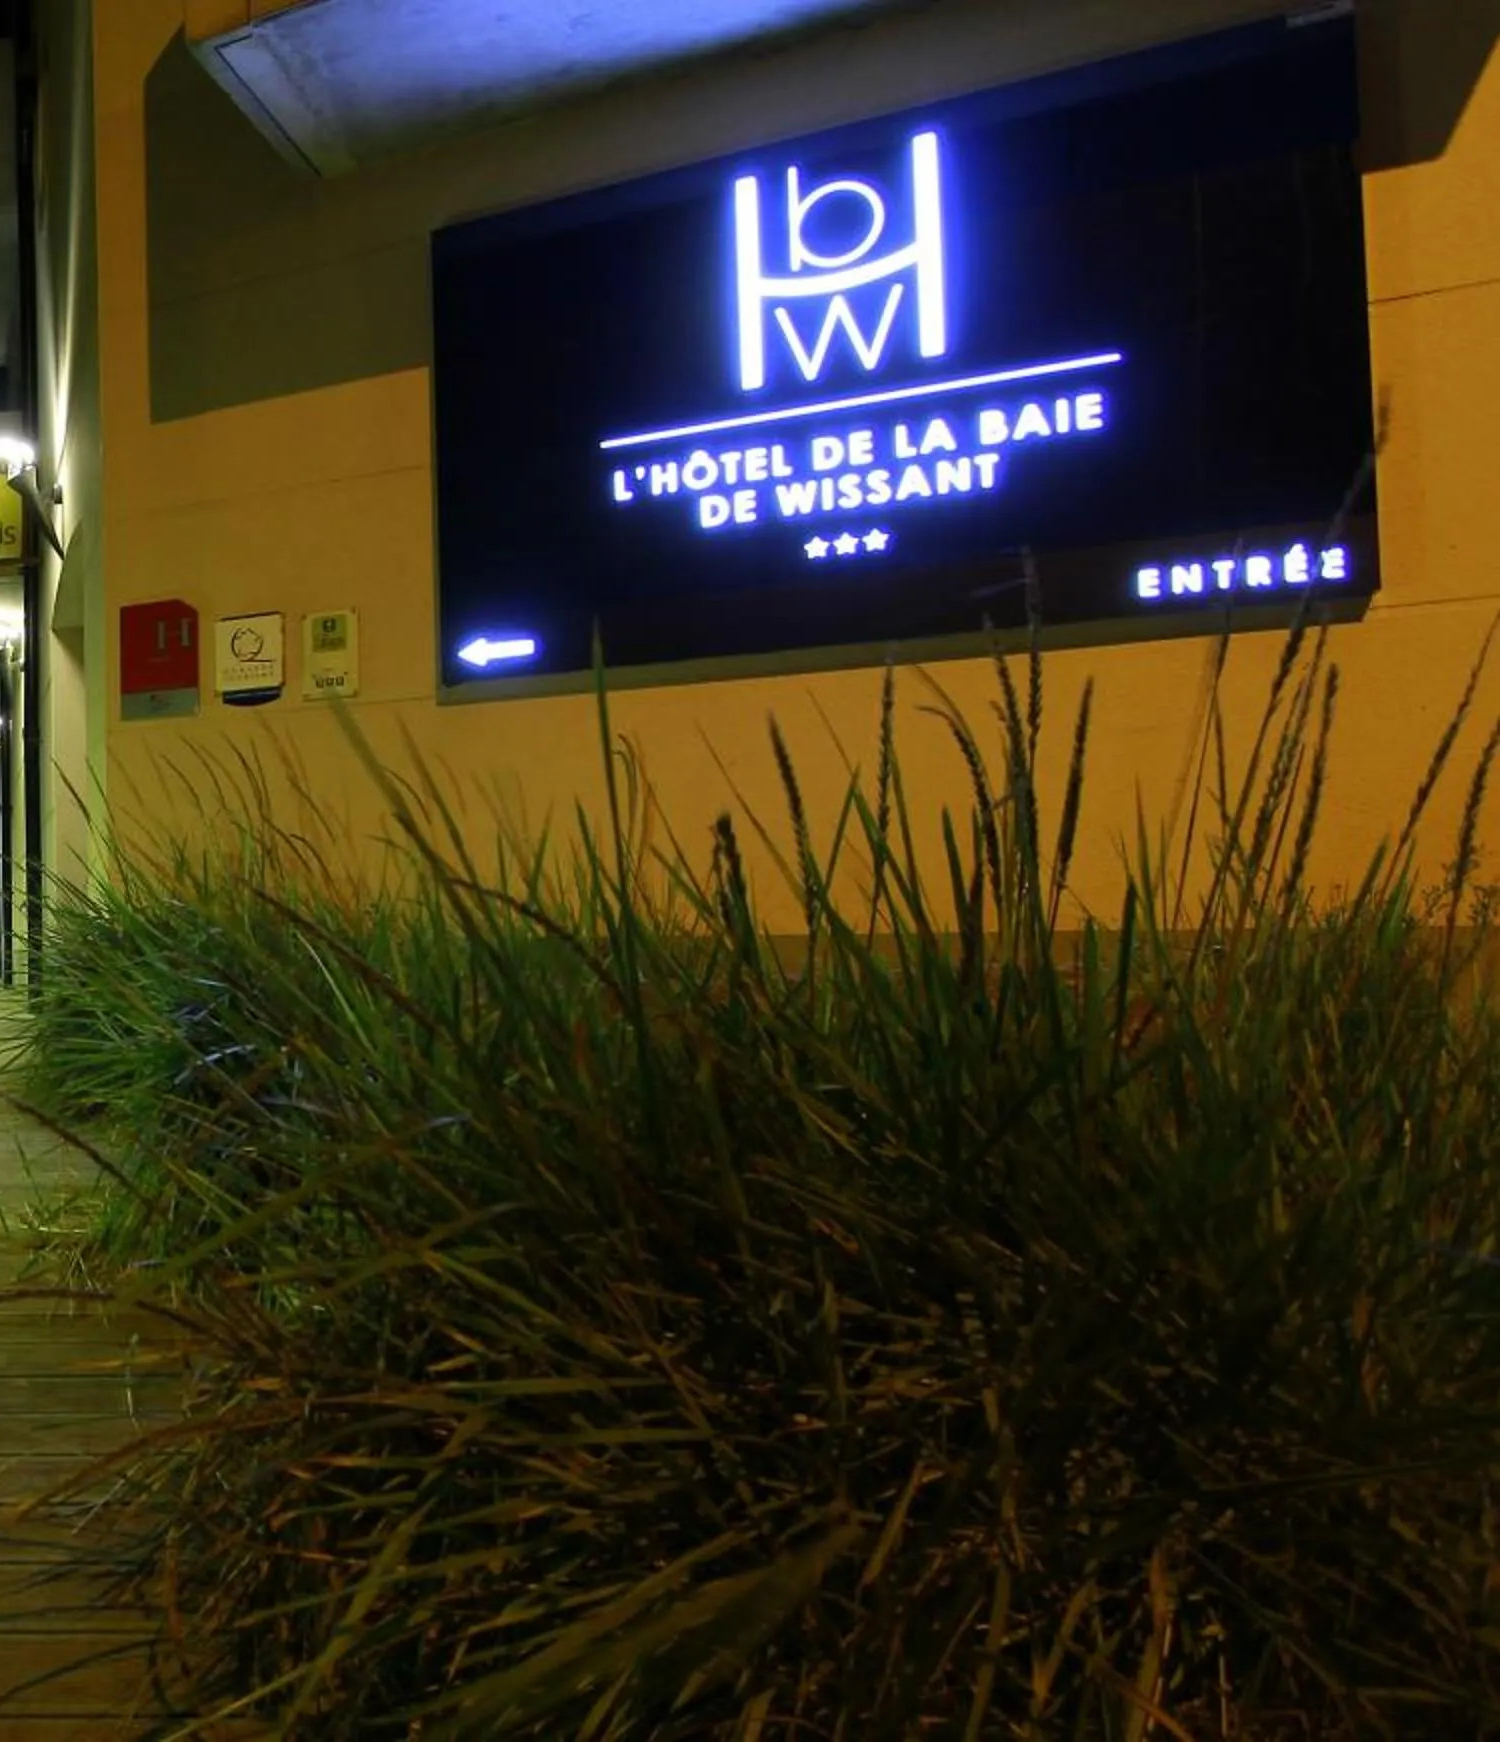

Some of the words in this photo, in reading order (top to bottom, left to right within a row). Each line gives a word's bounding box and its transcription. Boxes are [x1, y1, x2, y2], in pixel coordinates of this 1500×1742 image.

[613, 449, 792, 502] L'HÔTEL
[812, 430, 874, 471] DE
[894, 418, 957, 459] LA
[979, 393, 1104, 446] BAIE
[700, 489, 757, 528] DE
[777, 452, 1000, 517] WISSANT
[1137, 543, 1345, 598] ENTRÉE
